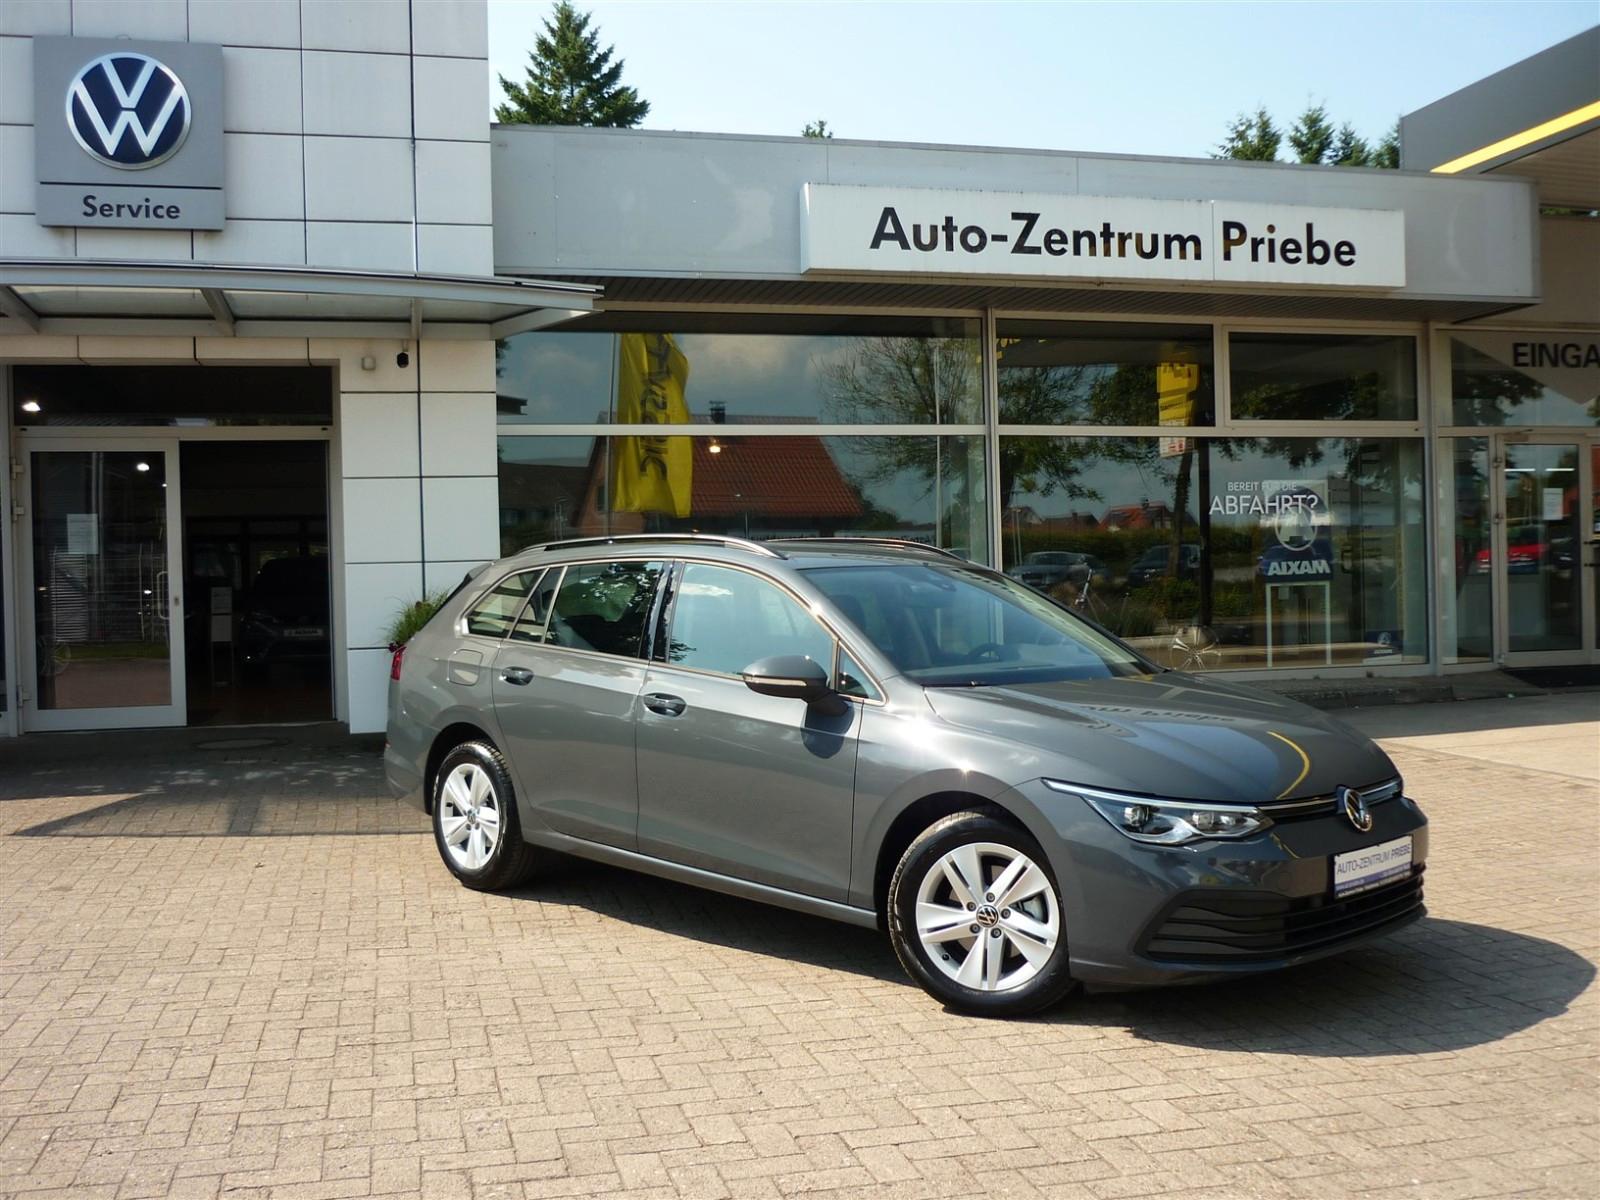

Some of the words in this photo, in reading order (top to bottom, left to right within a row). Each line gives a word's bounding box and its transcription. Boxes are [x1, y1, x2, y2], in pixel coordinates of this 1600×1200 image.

[82, 194, 181, 219] Service
[869, 206, 1202, 261] Auto-Zentrum
[1222, 220, 1356, 267] Priebe
[1513, 342, 1600, 368] EINGA
[1227, 481, 1259, 491] BEREIT
[1282, 481, 1297, 491] DIE
[1208, 494, 1318, 515] ABFAHRT?
[1267, 560, 1331, 576] AIXAM
